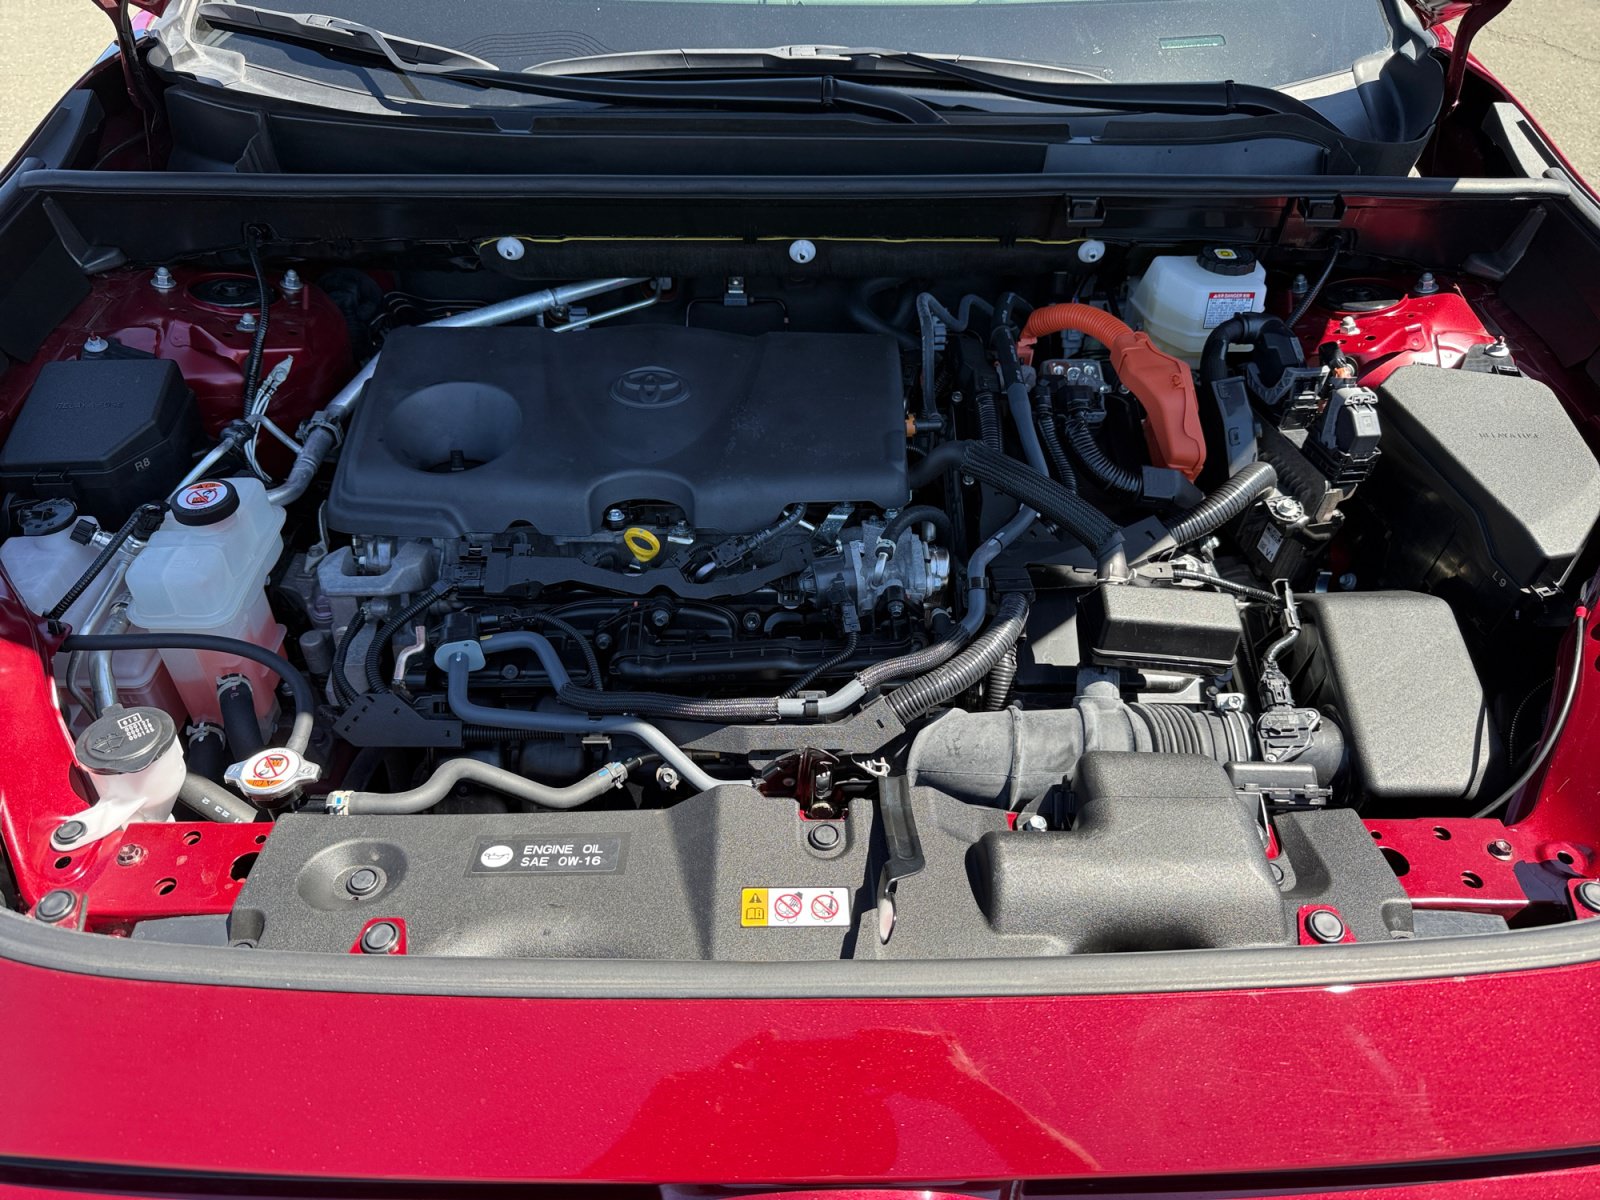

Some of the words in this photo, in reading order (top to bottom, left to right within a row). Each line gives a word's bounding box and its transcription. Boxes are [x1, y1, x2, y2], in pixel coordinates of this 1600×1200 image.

[134, 457, 151, 472] R8
[1491, 570, 1507, 588] L9
[523, 844, 574, 855] ENGINE
[582, 844, 604, 854] OIL
[520, 856, 550, 867] SAE
[557, 855, 602, 866] 0W-16
